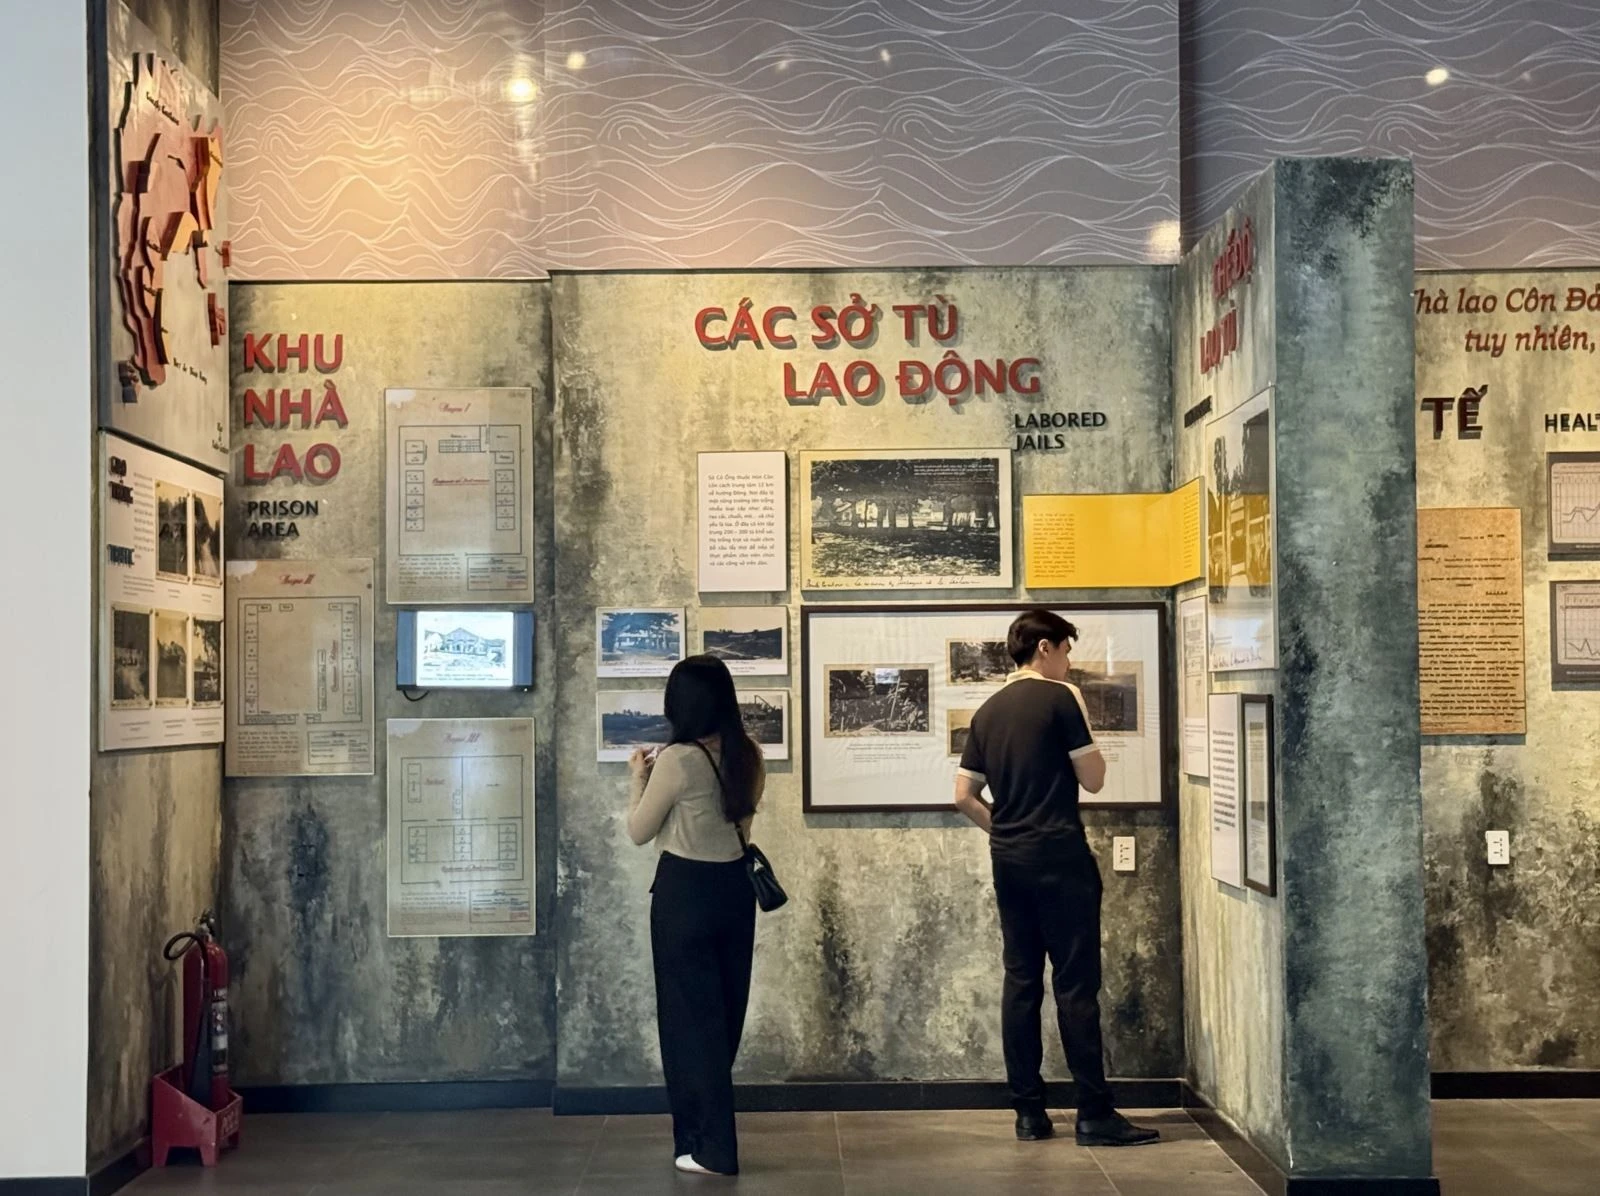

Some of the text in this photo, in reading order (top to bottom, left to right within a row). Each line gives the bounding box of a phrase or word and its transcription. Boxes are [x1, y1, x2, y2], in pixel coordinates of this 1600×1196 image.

[1457, 287, 1498, 314] lao
[1505, 286, 1557, 313] Côn
[694, 293, 962, 350] CÁC SỞ TÙ
[243, 333, 343, 373] KHU
[1464, 323, 1597, 358] tuy nhiên,
[782, 350, 1042, 414] LAO ĐỘNG
[243, 379, 348, 429] NHÀ
[1014, 412, 1107, 429] LABORED
[1420, 384, 1489, 440] TẾ
[1013, 434, 1065, 452] JAILS
[242, 443, 341, 485] LAO
[248, 500, 319, 516] PRISON
[247, 522, 300, 537] AREA
